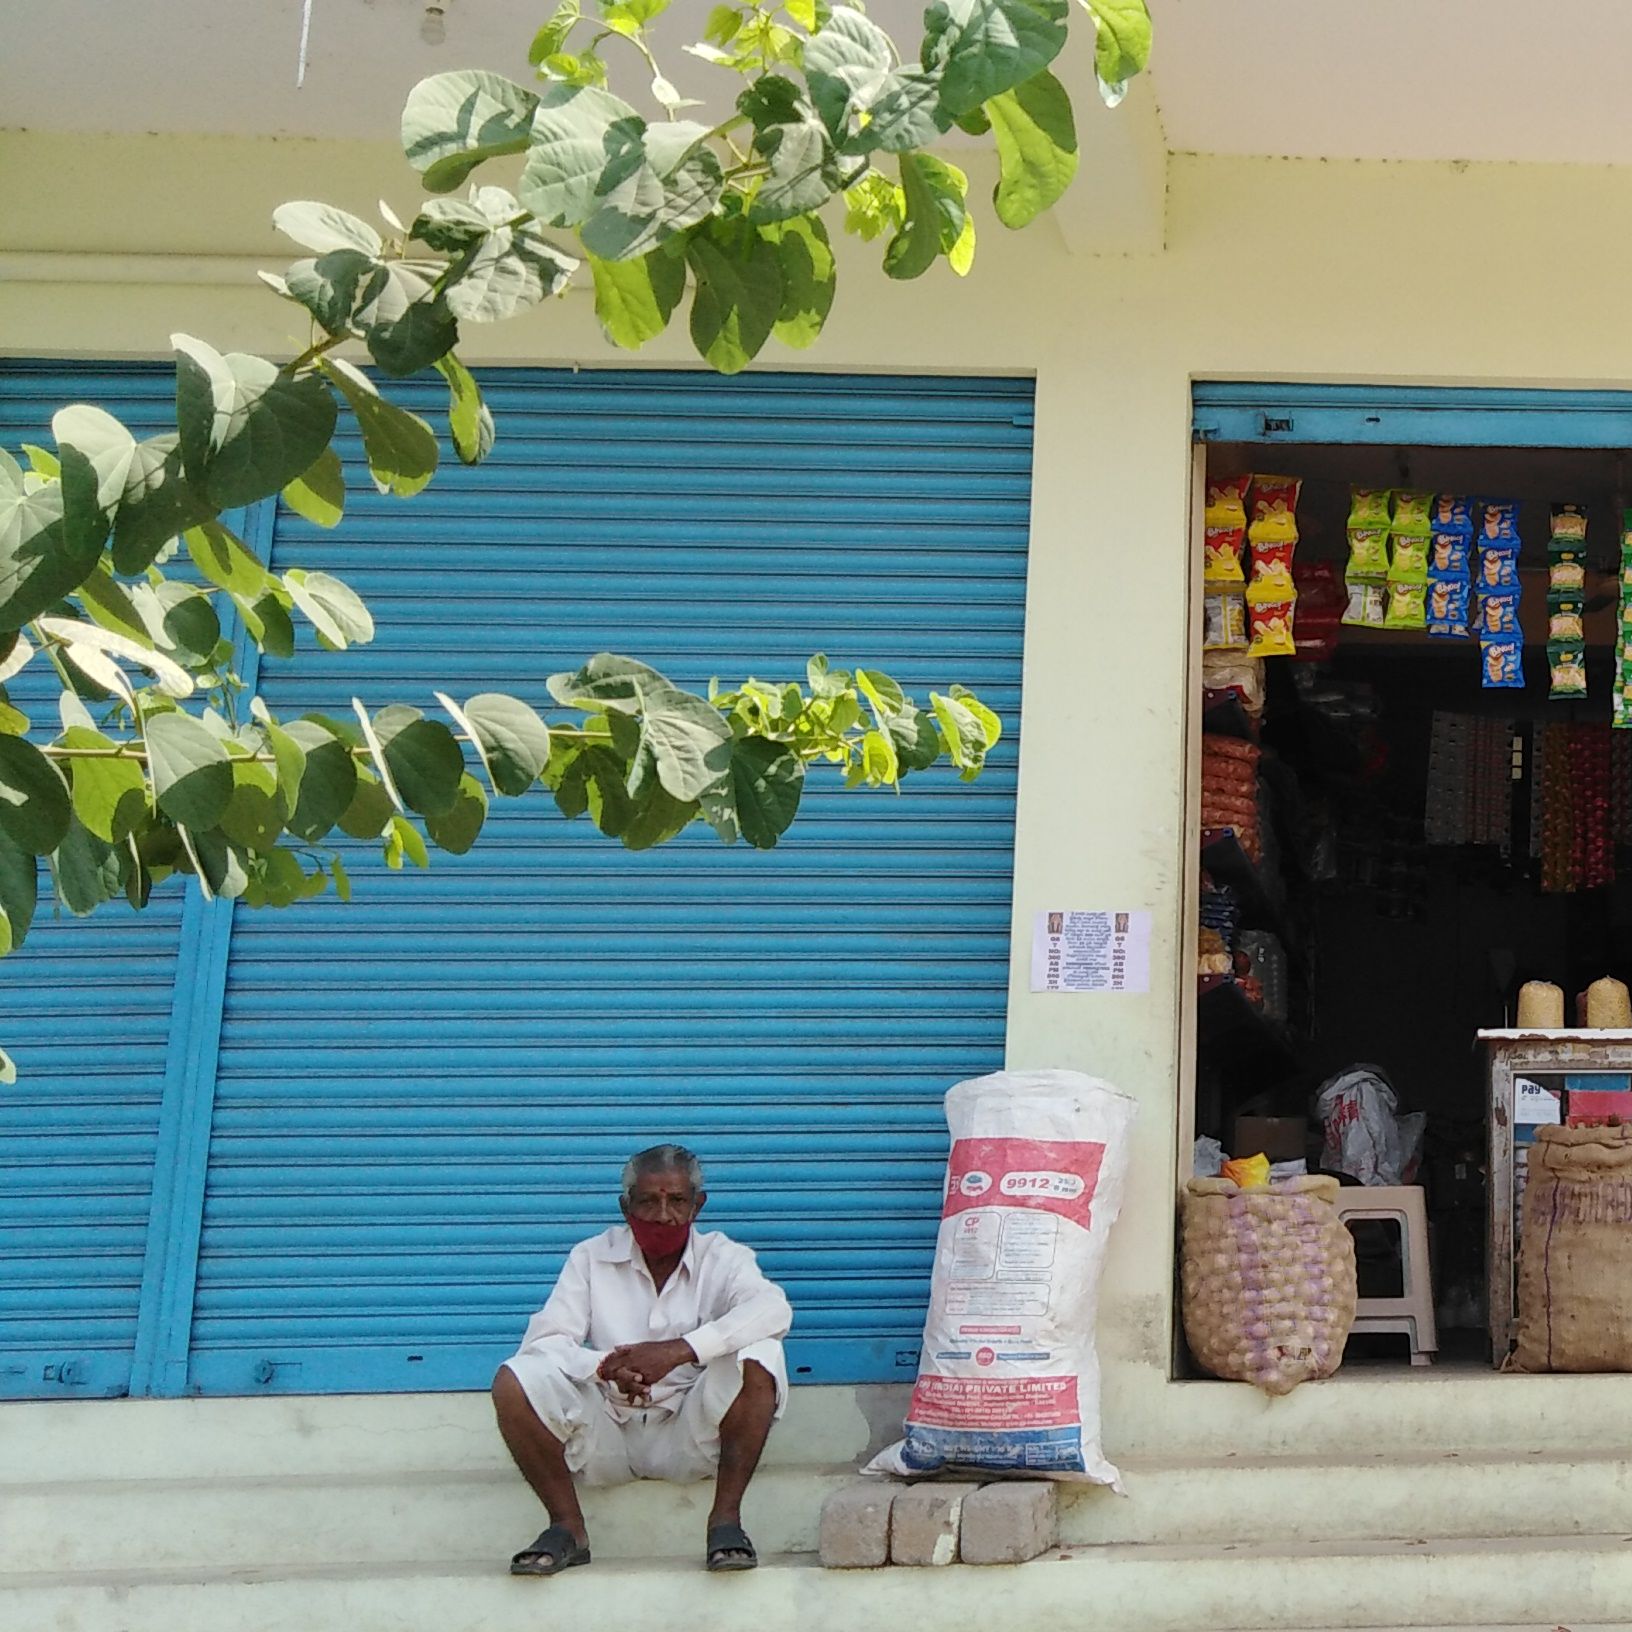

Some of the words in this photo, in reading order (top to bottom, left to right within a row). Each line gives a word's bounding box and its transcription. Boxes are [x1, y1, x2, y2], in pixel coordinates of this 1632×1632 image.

[1006, 1178, 1050, 1190] 9912
[965, 1384, 1016, 1394] PRIVATE
[1019, 1381, 1068, 1393] LIMITED
